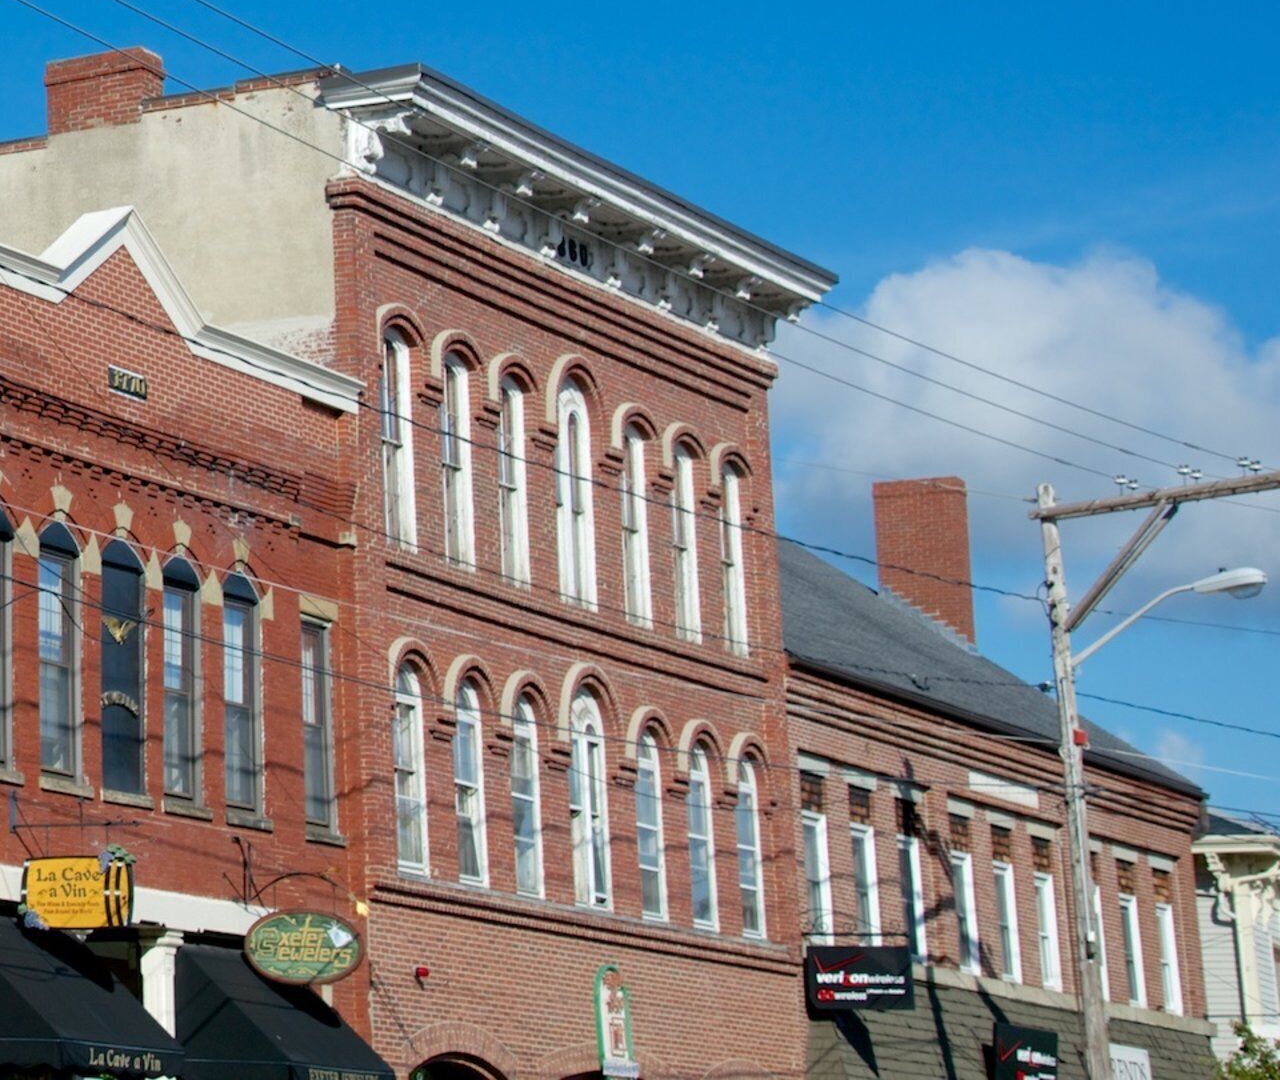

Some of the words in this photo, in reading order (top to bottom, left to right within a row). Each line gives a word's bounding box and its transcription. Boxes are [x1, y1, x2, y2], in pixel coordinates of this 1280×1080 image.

[36, 868, 57, 882] La
[62, 867, 101, 882] Cave
[49, 887, 58, 898] a
[60, 883, 87, 898] Vin
[90, 1047, 105, 1066] La
[106, 1049, 131, 1069] Cave
[134, 1056, 141, 1069] a
[142, 1052, 161, 1072] Vin
